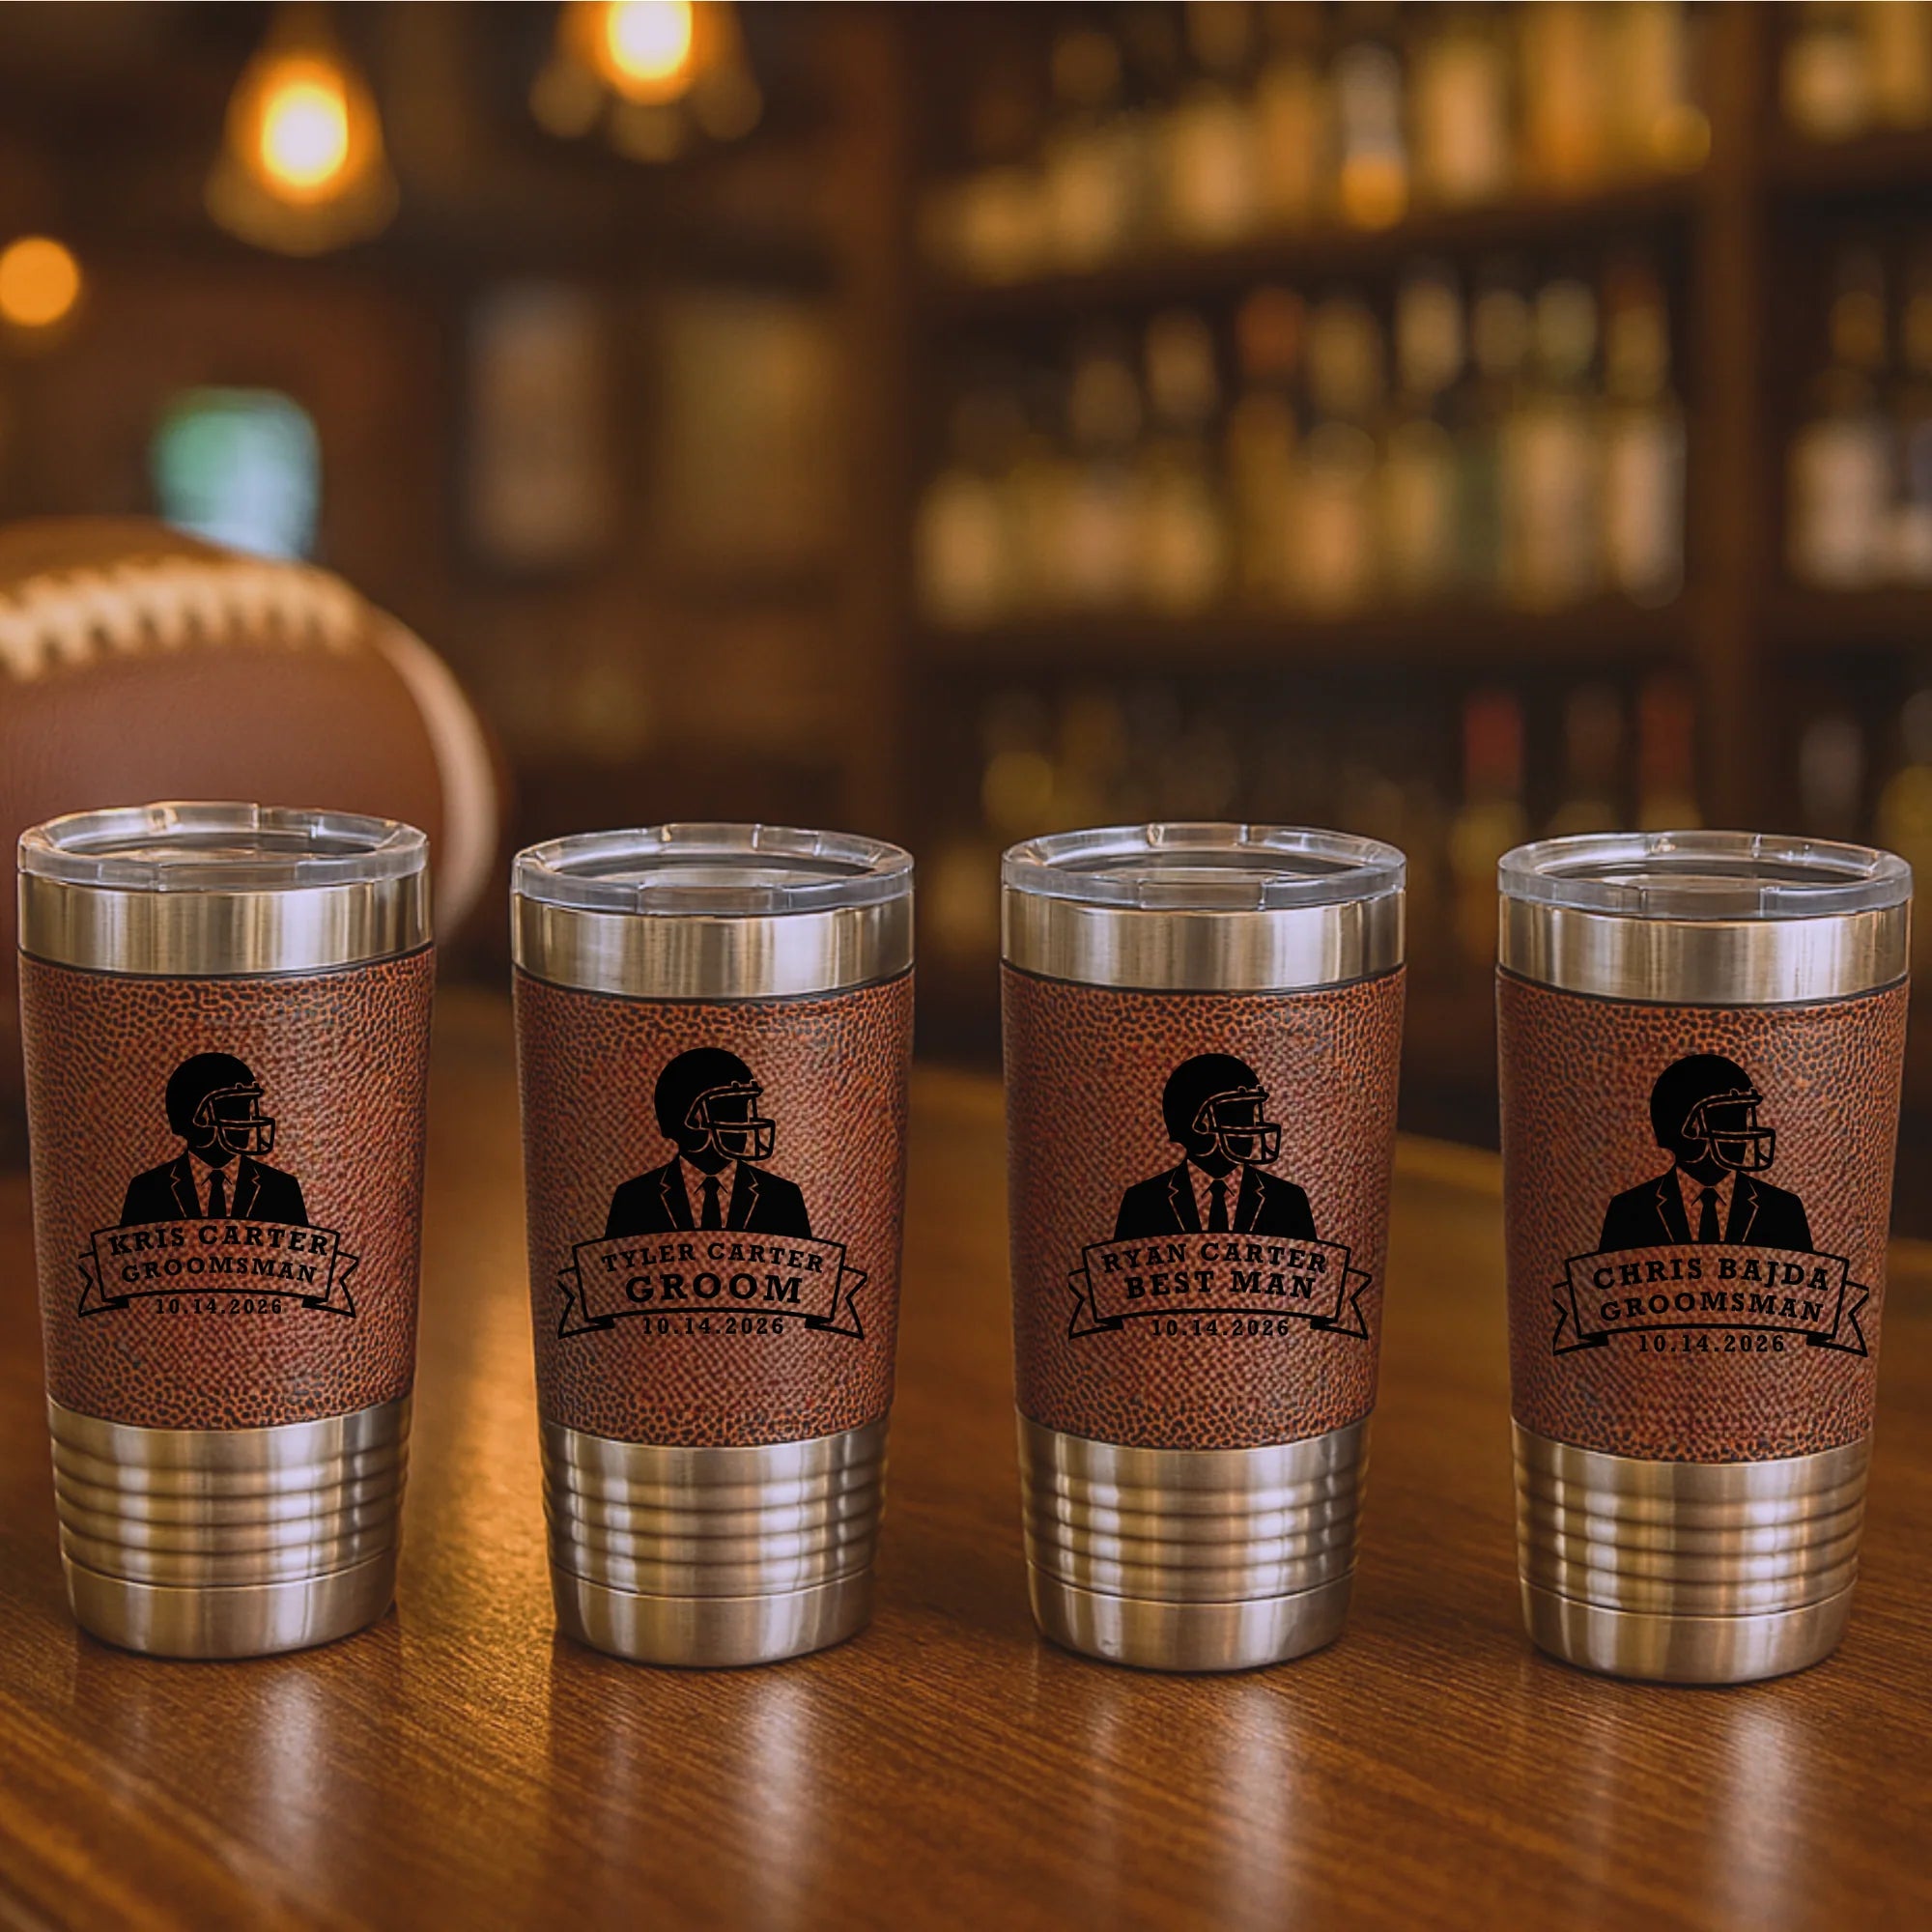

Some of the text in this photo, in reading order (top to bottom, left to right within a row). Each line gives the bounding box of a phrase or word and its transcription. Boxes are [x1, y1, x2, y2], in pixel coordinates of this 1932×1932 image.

[108, 1225, 328, 1256] KRIS CARTER
[122, 1256, 317, 1284] GROOMSMAN
[601, 1242, 823, 1273] TYLER CARTER
[1101, 1242, 1327, 1274] RYAN CARTER
[625, 1272, 803, 1304] GROOM
[1124, 1270, 1317, 1299] BEST MAN
[1594, 1258, 1829, 1292] CHRIS BAJDA
[156, 1298, 282, 1315] 10.14.2026
[1600, 1292, 1824, 1322] GROOMSMAN
[643, 1317, 783, 1335] 10.14.2026
[1152, 1320, 1289, 1337] 10.14.2026
[1638, 1334, 1784, 1352] 10.14.2026
